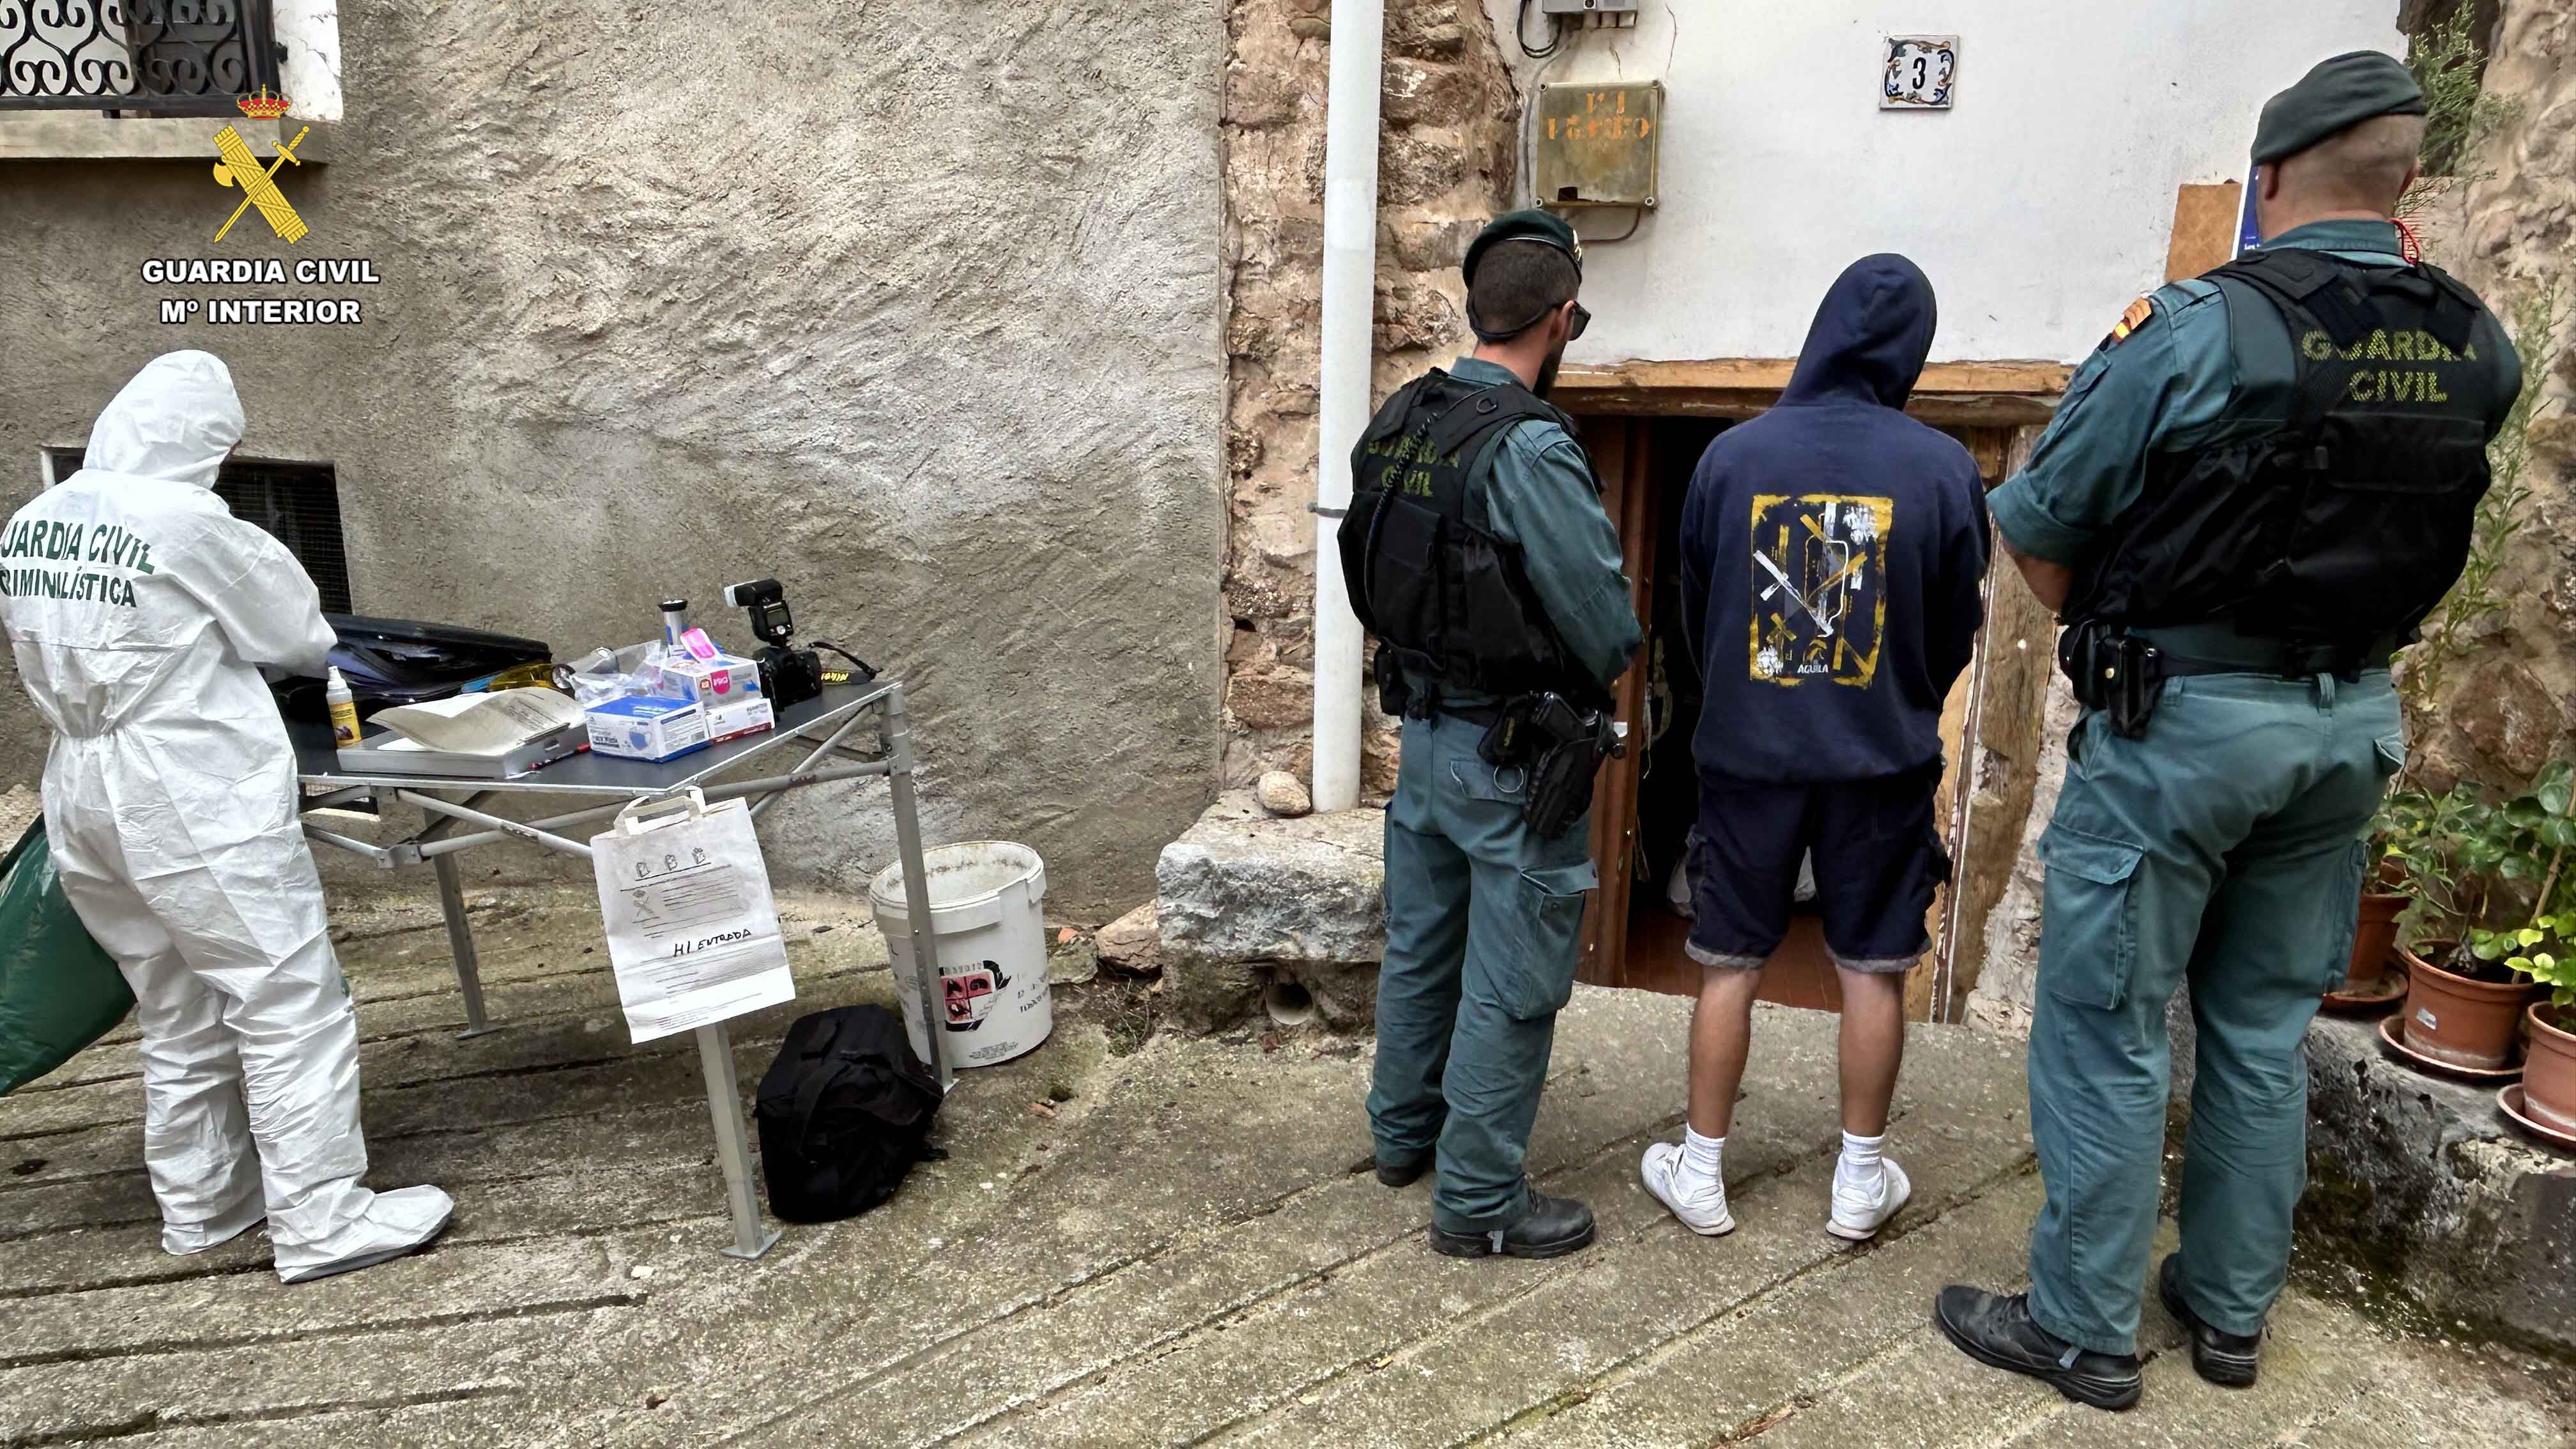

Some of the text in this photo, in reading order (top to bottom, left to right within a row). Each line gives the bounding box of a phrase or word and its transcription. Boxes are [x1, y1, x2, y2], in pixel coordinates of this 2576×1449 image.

[1913, 57, 1927, 89] 3
[2349, 369, 2448, 402] CIVIL
[1381, 465, 1434, 496] CVIL
[0, 520, 155, 575] UARDIA CIVIL
[698, 928, 752, 951] ENTRADA
